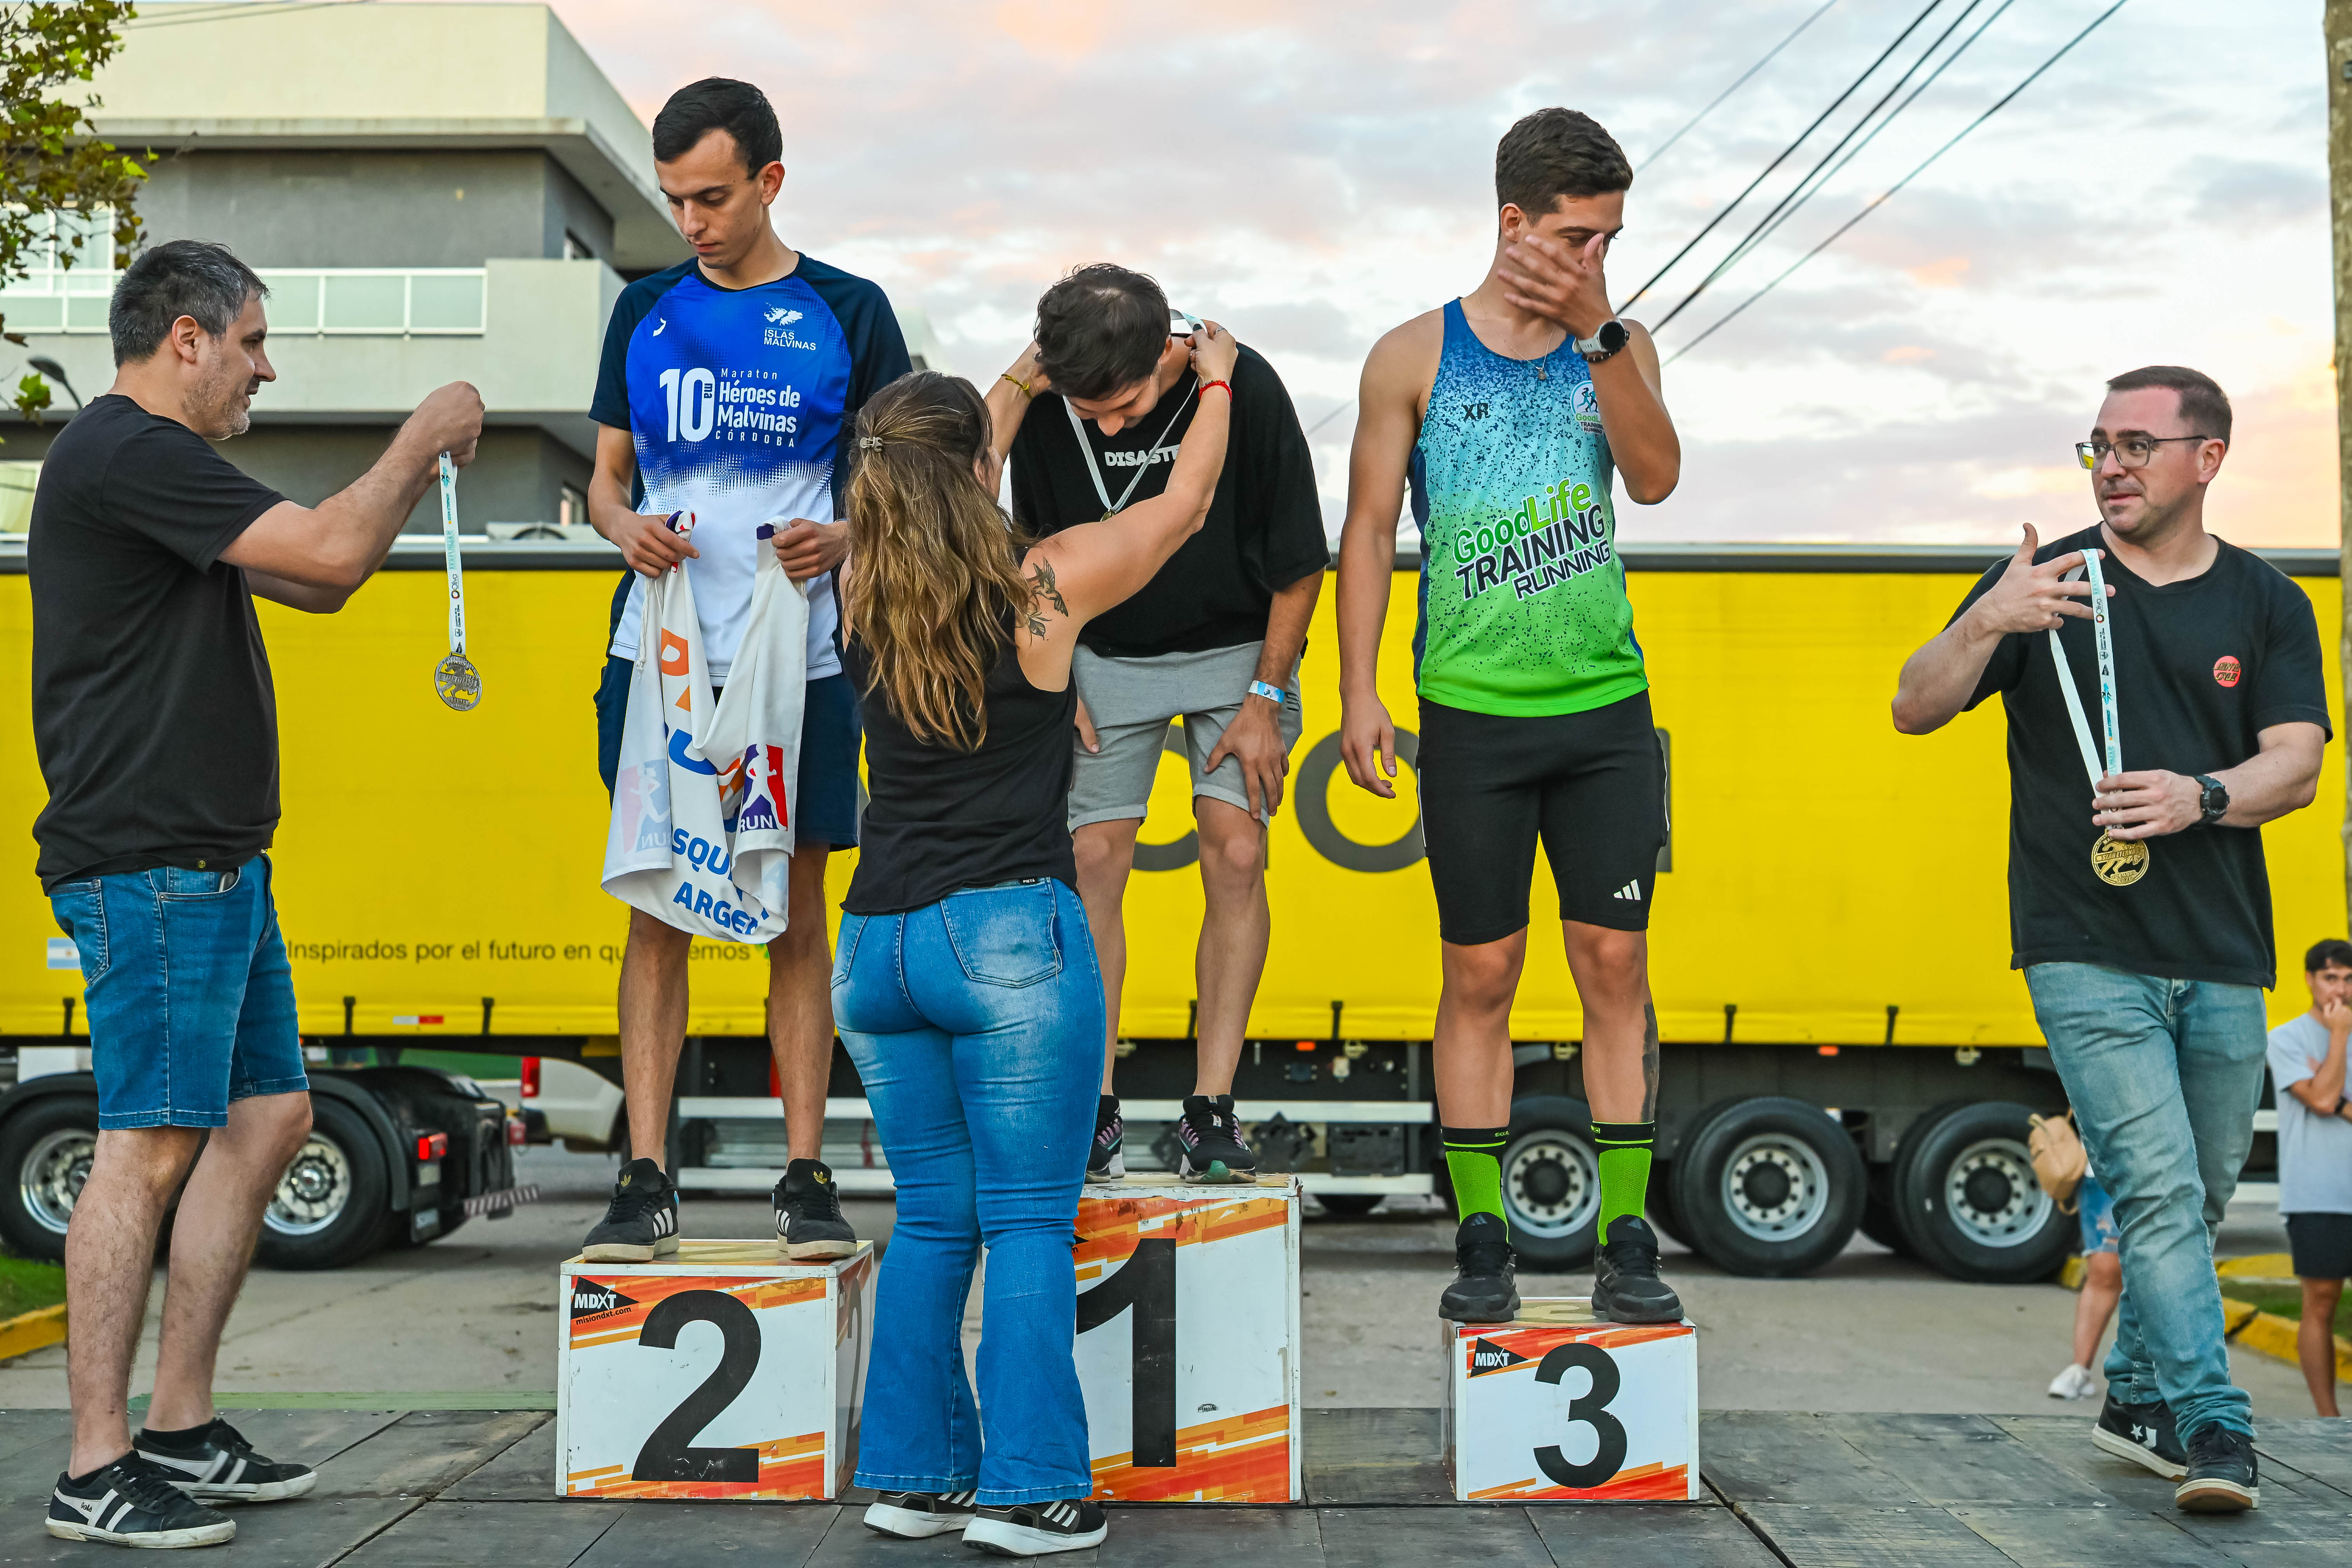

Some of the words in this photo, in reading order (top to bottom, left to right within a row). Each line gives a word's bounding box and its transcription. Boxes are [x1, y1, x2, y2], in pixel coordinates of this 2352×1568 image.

[764, 337, 816, 350] MALVINAS
[765, 329, 794, 340] ISLAS
[721, 367, 778, 380] Maraton
[659, 368, 715, 443] 10
[719, 379, 776, 406] Héroes
[779, 385, 800, 408] de
[718, 406, 796, 433] Malvinas
[1576, 413, 1601, 423] GoodL
[716, 429, 794, 448] CÓRDOBA
[1454, 479, 1591, 564] GoodLife
[1456, 504, 1604, 599] TRAINING
[1512, 540, 1610, 600] RUNNING
[288, 940, 407, 964] Inspirados
[416, 943, 454, 964] por
[462, 940, 481, 960] el
[489, 939, 556, 960] futuro
[564, 944, 588, 960] en
[598, 944, 625, 965] qu
[689, 943, 750, 960] emos
[574, 1289, 616, 1310] MDXT
[576, 1307, 632, 1325] misiondxt.com
[1076, 1238, 1176, 1468] 1
[1475, 1348, 1510, 1367] MDXT
[632, 1290, 761, 1482] 2
[1533, 1342, 1628, 1488] 3
[81, 1502, 92, 1512] Gola
